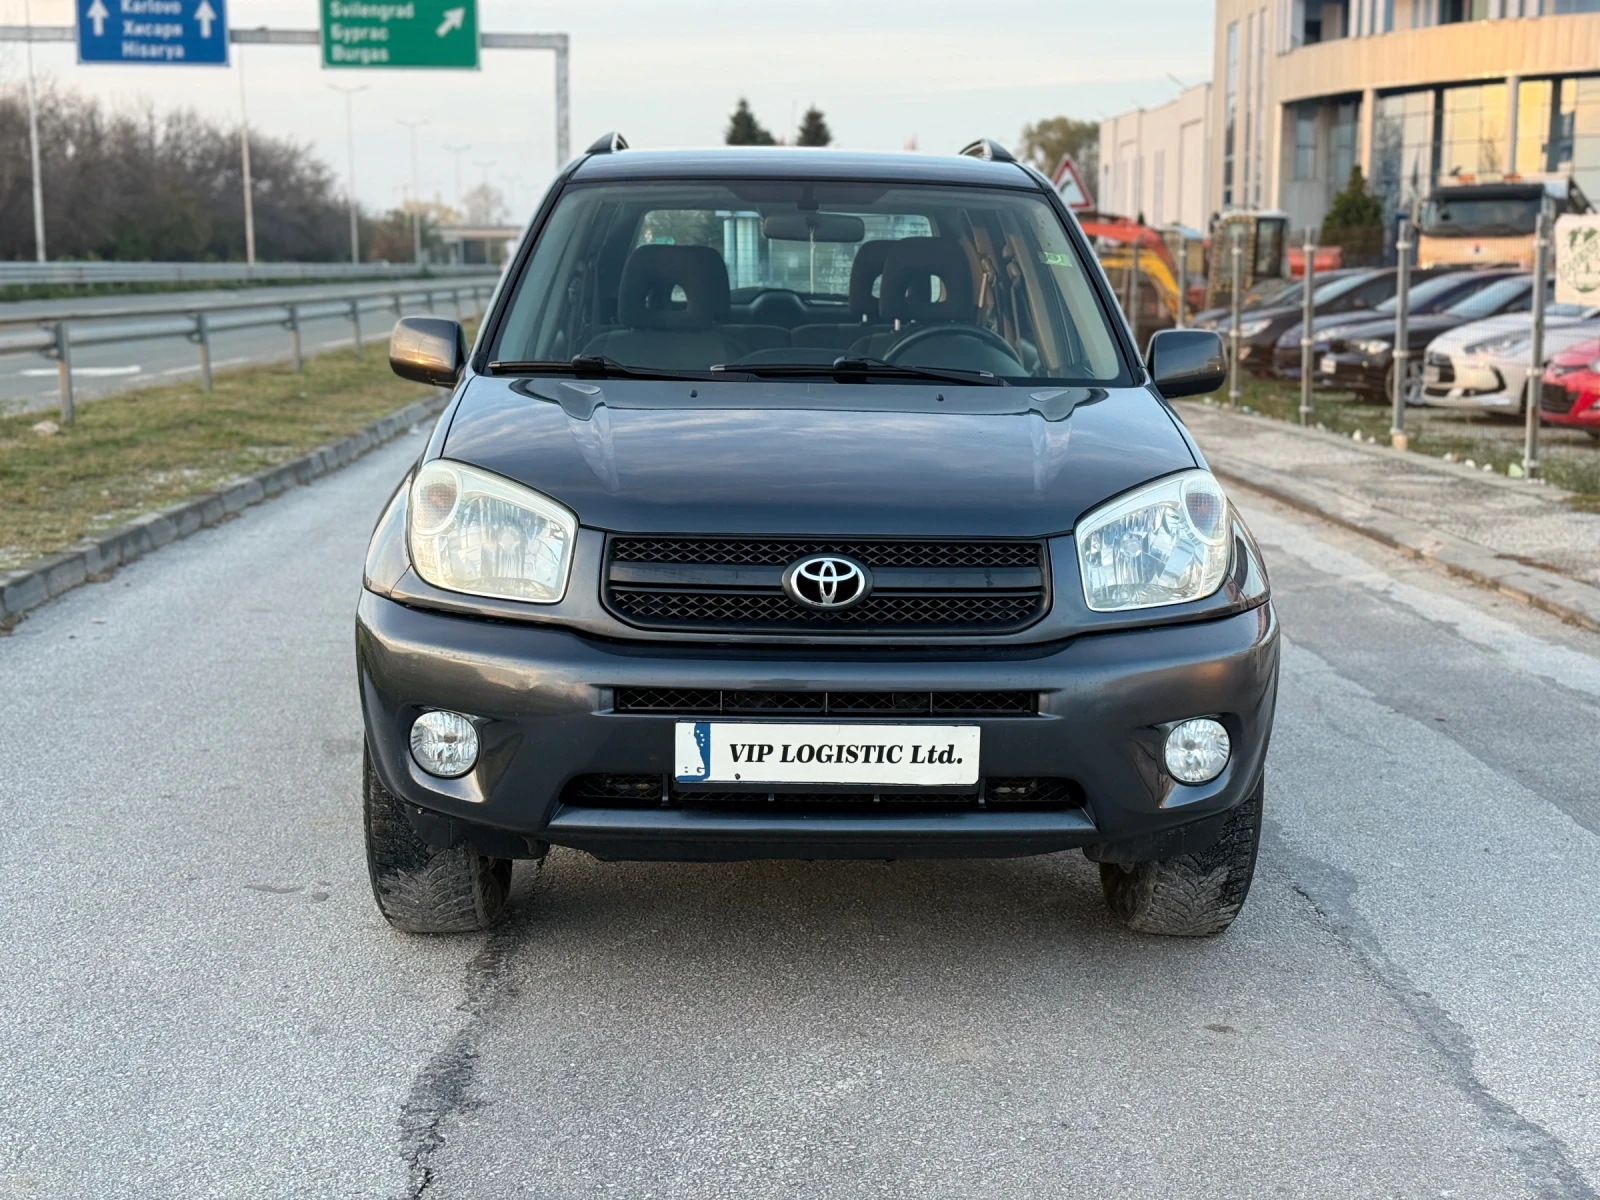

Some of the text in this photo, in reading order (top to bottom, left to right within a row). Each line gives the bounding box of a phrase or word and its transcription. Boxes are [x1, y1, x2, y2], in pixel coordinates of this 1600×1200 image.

[120, 0, 182, 14] Karlovo
[330, 1, 415, 21] Svilengrad
[122, 20, 183, 40] Хисаря
[330, 23, 389, 43] Бургас
[121, 41, 185, 60] Hisarya
[331, 44, 389, 64] Burgas
[729, 743, 964, 764] VIP LOGISTIC Ltd.
